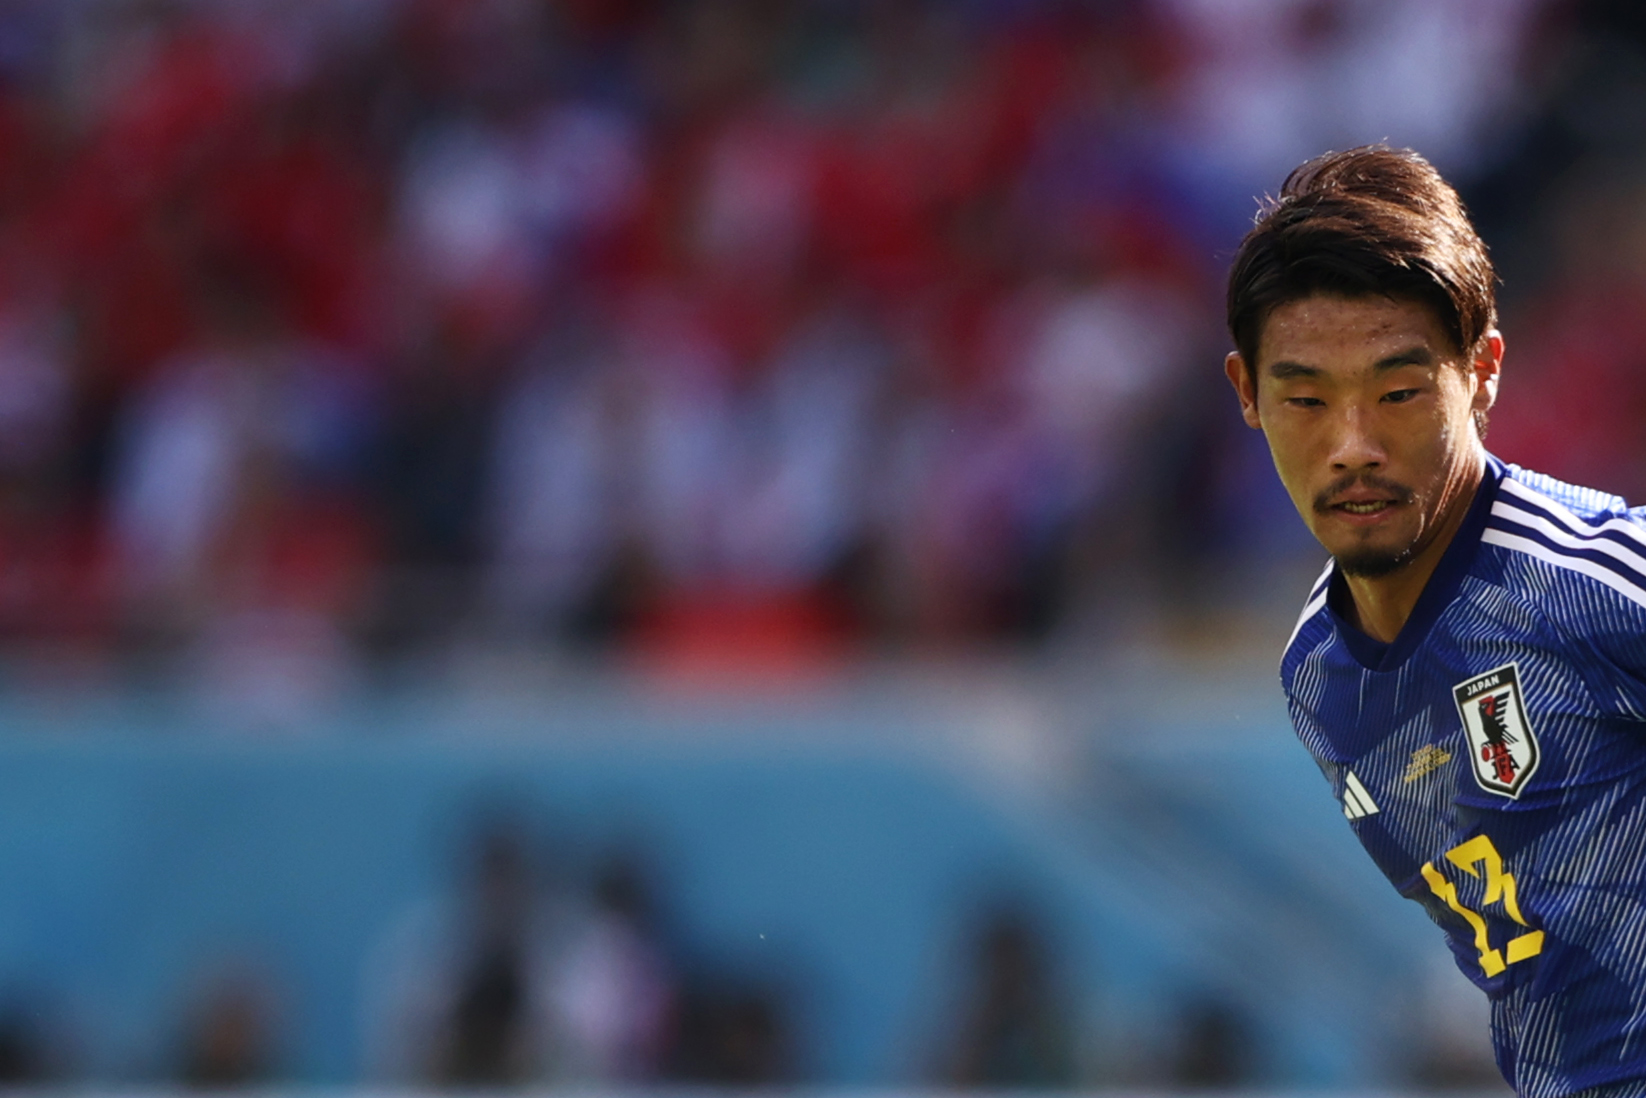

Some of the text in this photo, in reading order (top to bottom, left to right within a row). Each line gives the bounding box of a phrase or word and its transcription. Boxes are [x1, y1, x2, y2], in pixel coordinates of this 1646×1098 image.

[1467, 674, 1500, 697] JAPAN
[1491, 752, 1520, 780] JFA
[1421, 834, 1544, 979] 13
